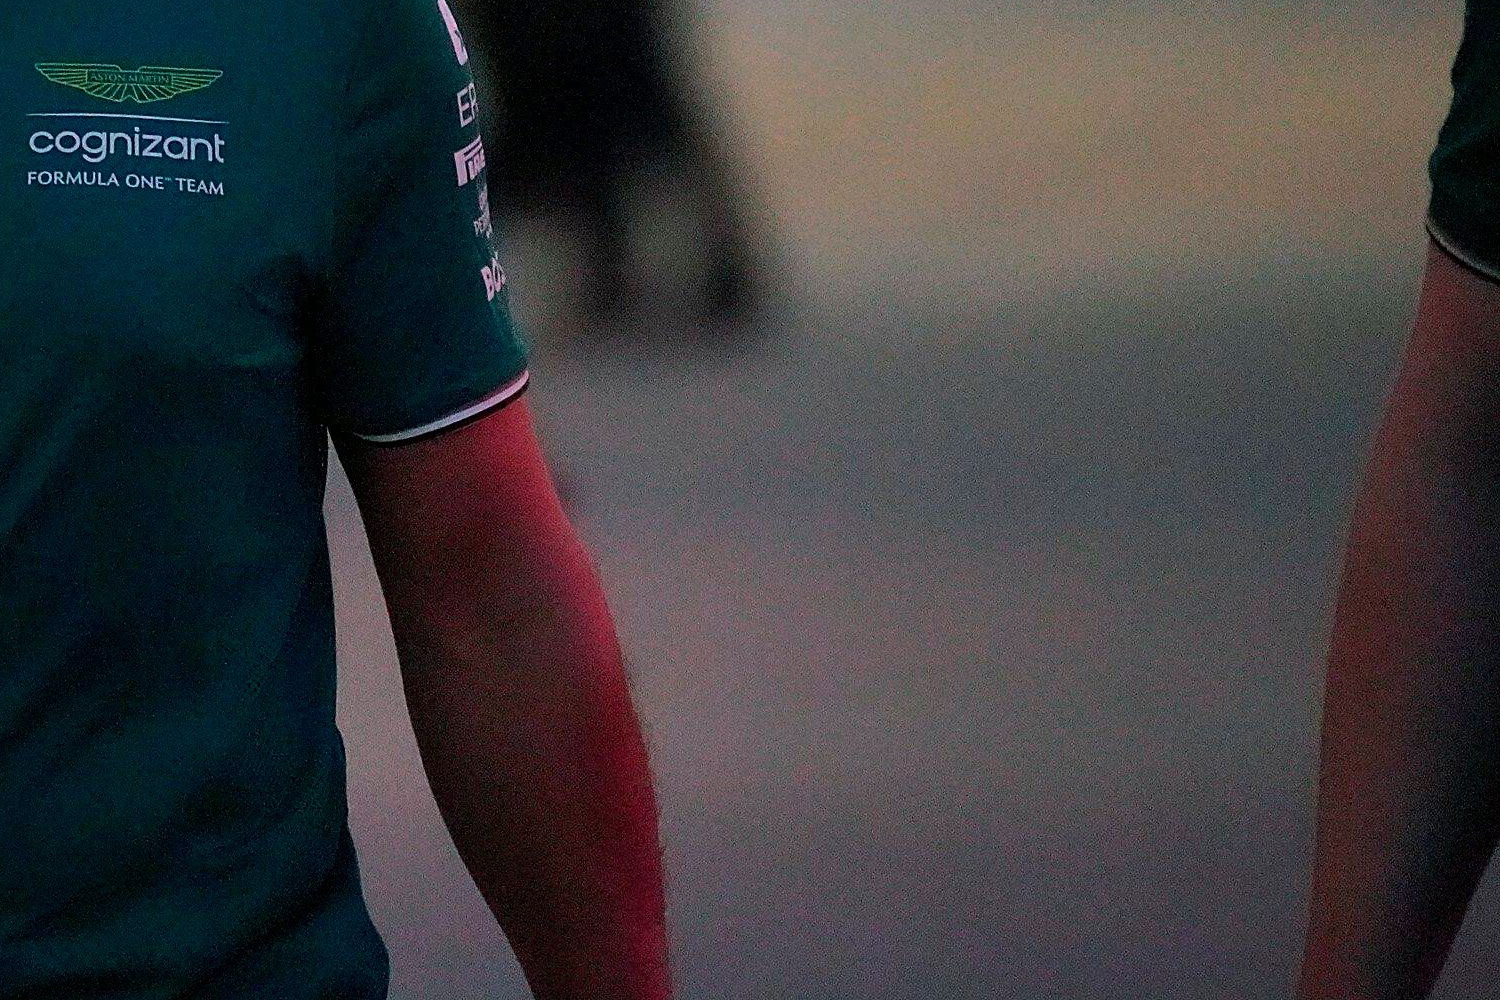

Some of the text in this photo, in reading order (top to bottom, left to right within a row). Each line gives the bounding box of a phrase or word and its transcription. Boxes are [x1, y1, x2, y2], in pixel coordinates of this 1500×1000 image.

[90, 73, 170, 83] ASTON MARTIN
[28, 126, 225, 163] cognizant
[27, 170, 119, 188] FORMULA
[175, 177, 224, 196] TEAM
